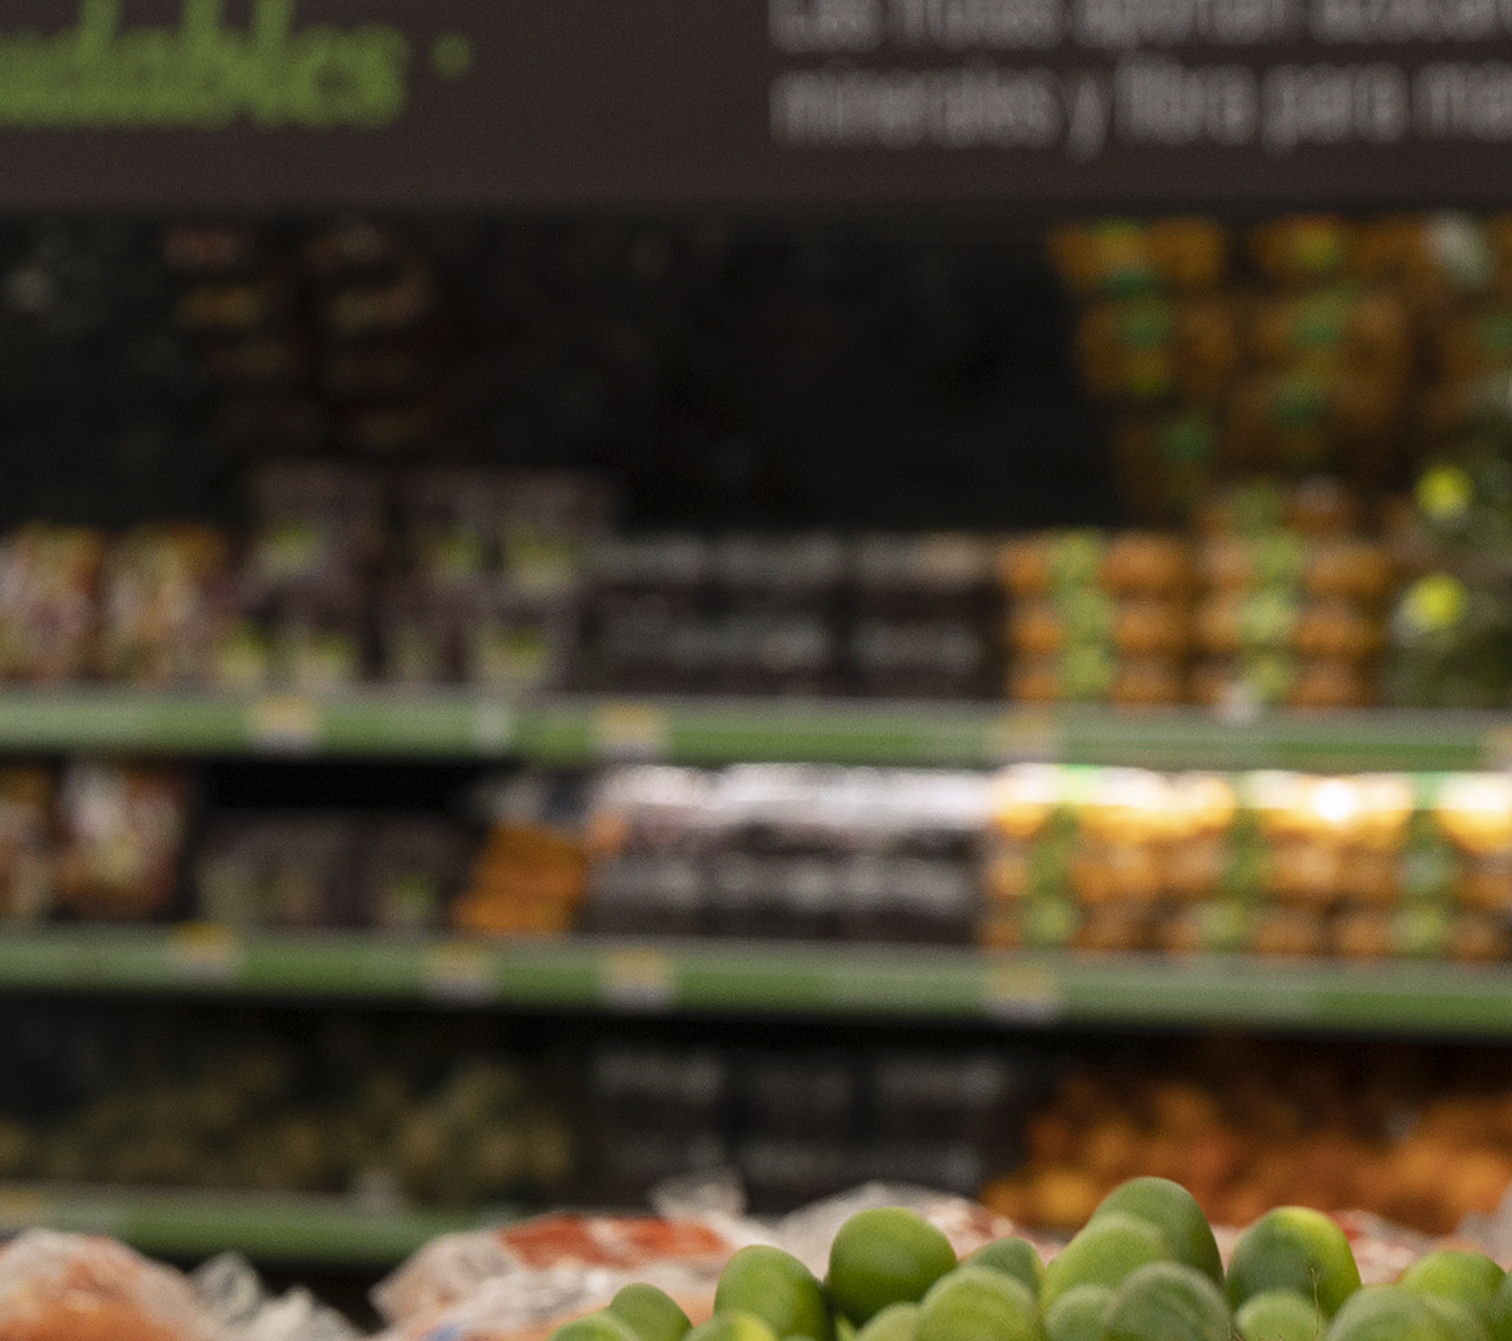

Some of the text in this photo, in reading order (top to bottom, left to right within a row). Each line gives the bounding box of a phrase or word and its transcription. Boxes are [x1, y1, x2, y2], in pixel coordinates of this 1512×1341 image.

[773, 62, 1059, 142] minerales
[1067, 74, 1106, 157] y
[1265, 66, 1406, 152] para
